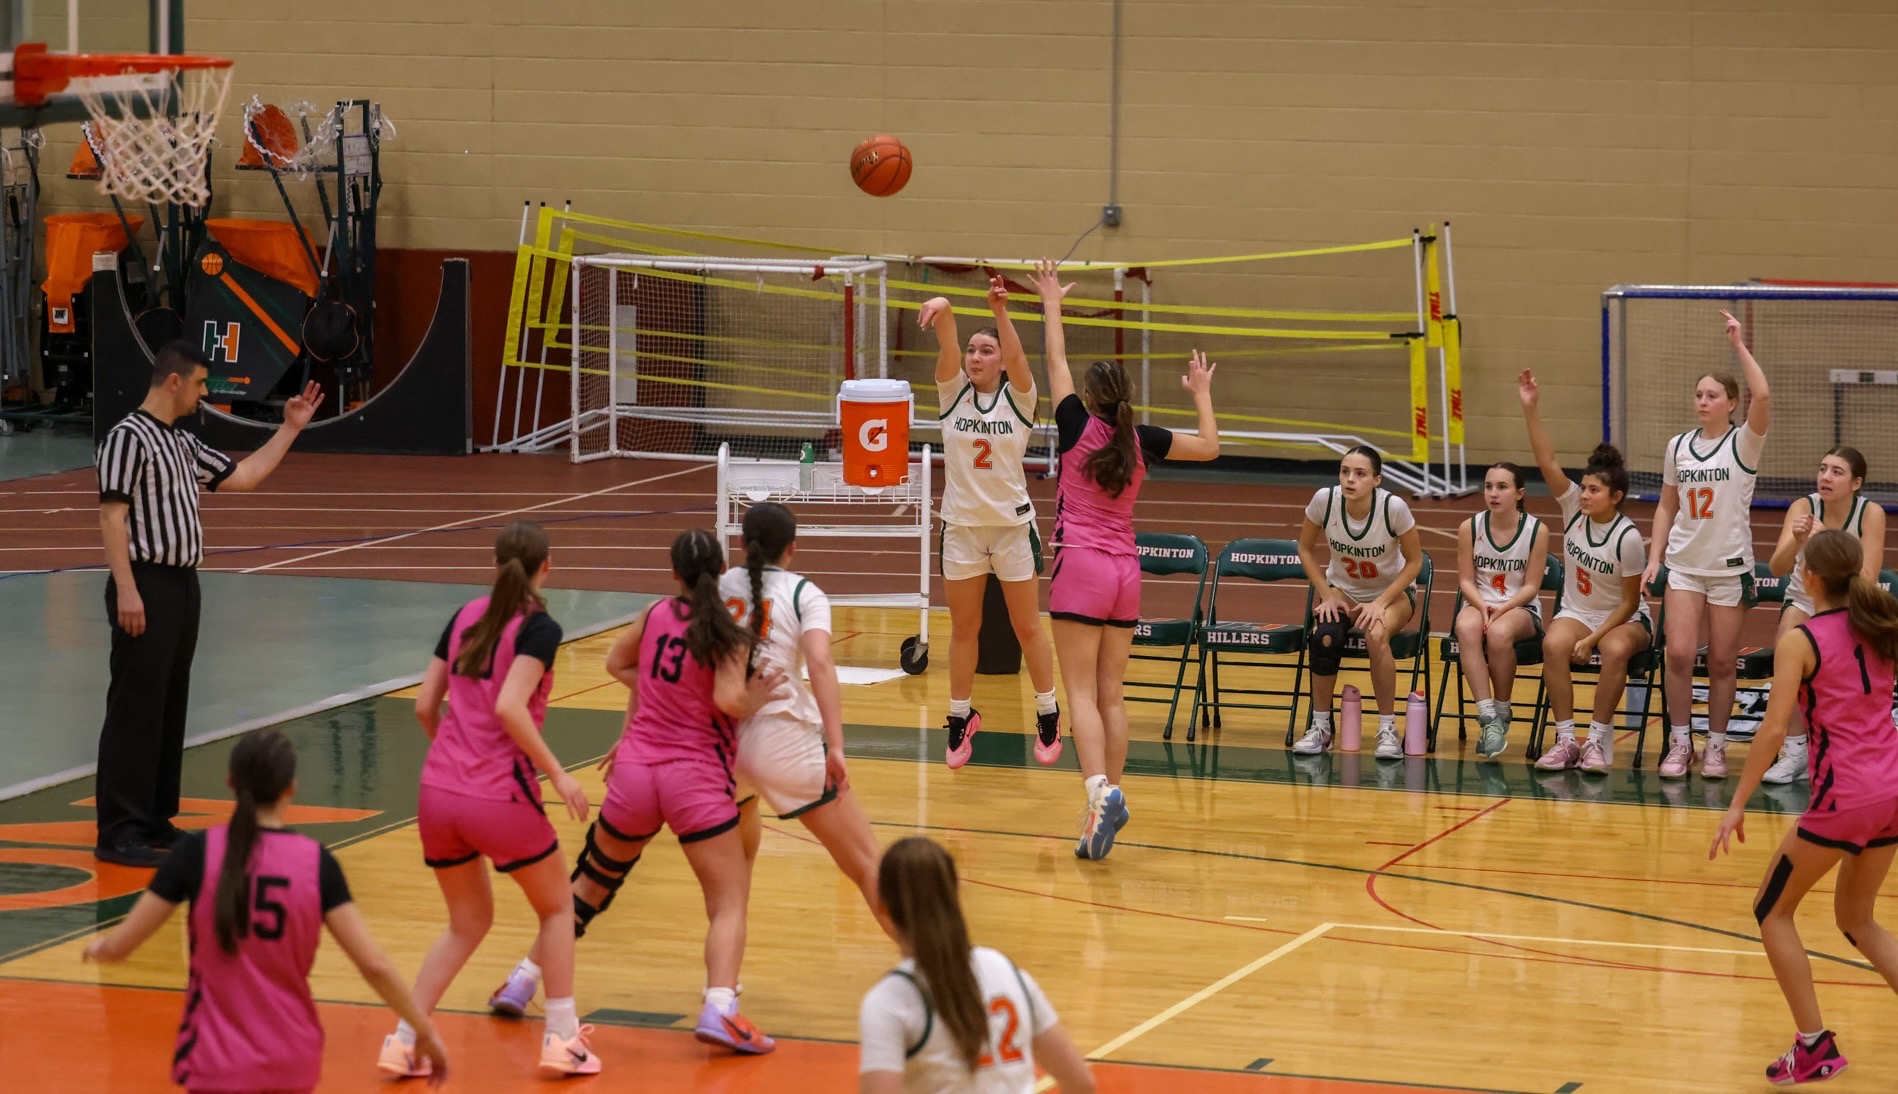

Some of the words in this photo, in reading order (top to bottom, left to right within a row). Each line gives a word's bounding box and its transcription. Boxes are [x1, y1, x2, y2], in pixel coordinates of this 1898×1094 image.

[1429, 291, 1442, 323] TIME
[1451, 389, 1463, 421] TIME
[858, 418, 888, 452] G
[953, 416, 1013, 435] HOPKINTON
[1415, 406, 1427, 438] TIME
[972, 438, 993, 470] 2
[1677, 467, 1730, 483] OPKINTON
[1686, 486, 1714, 520] 12
[1136, 545, 1195, 558] OPKINTON
[1329, 538, 1386, 557] HOPKINTON
[1566, 537, 1614, 575] HOPKINTON
[1340, 556, 1379, 580] 20
[1576, 565, 1593, 596] 5
[1490, 573, 1507, 596] 4
[1206, 631, 1270, 645] HILLERS
[651, 633, 688, 684] 13
[1853, 643, 1872, 695] 1
